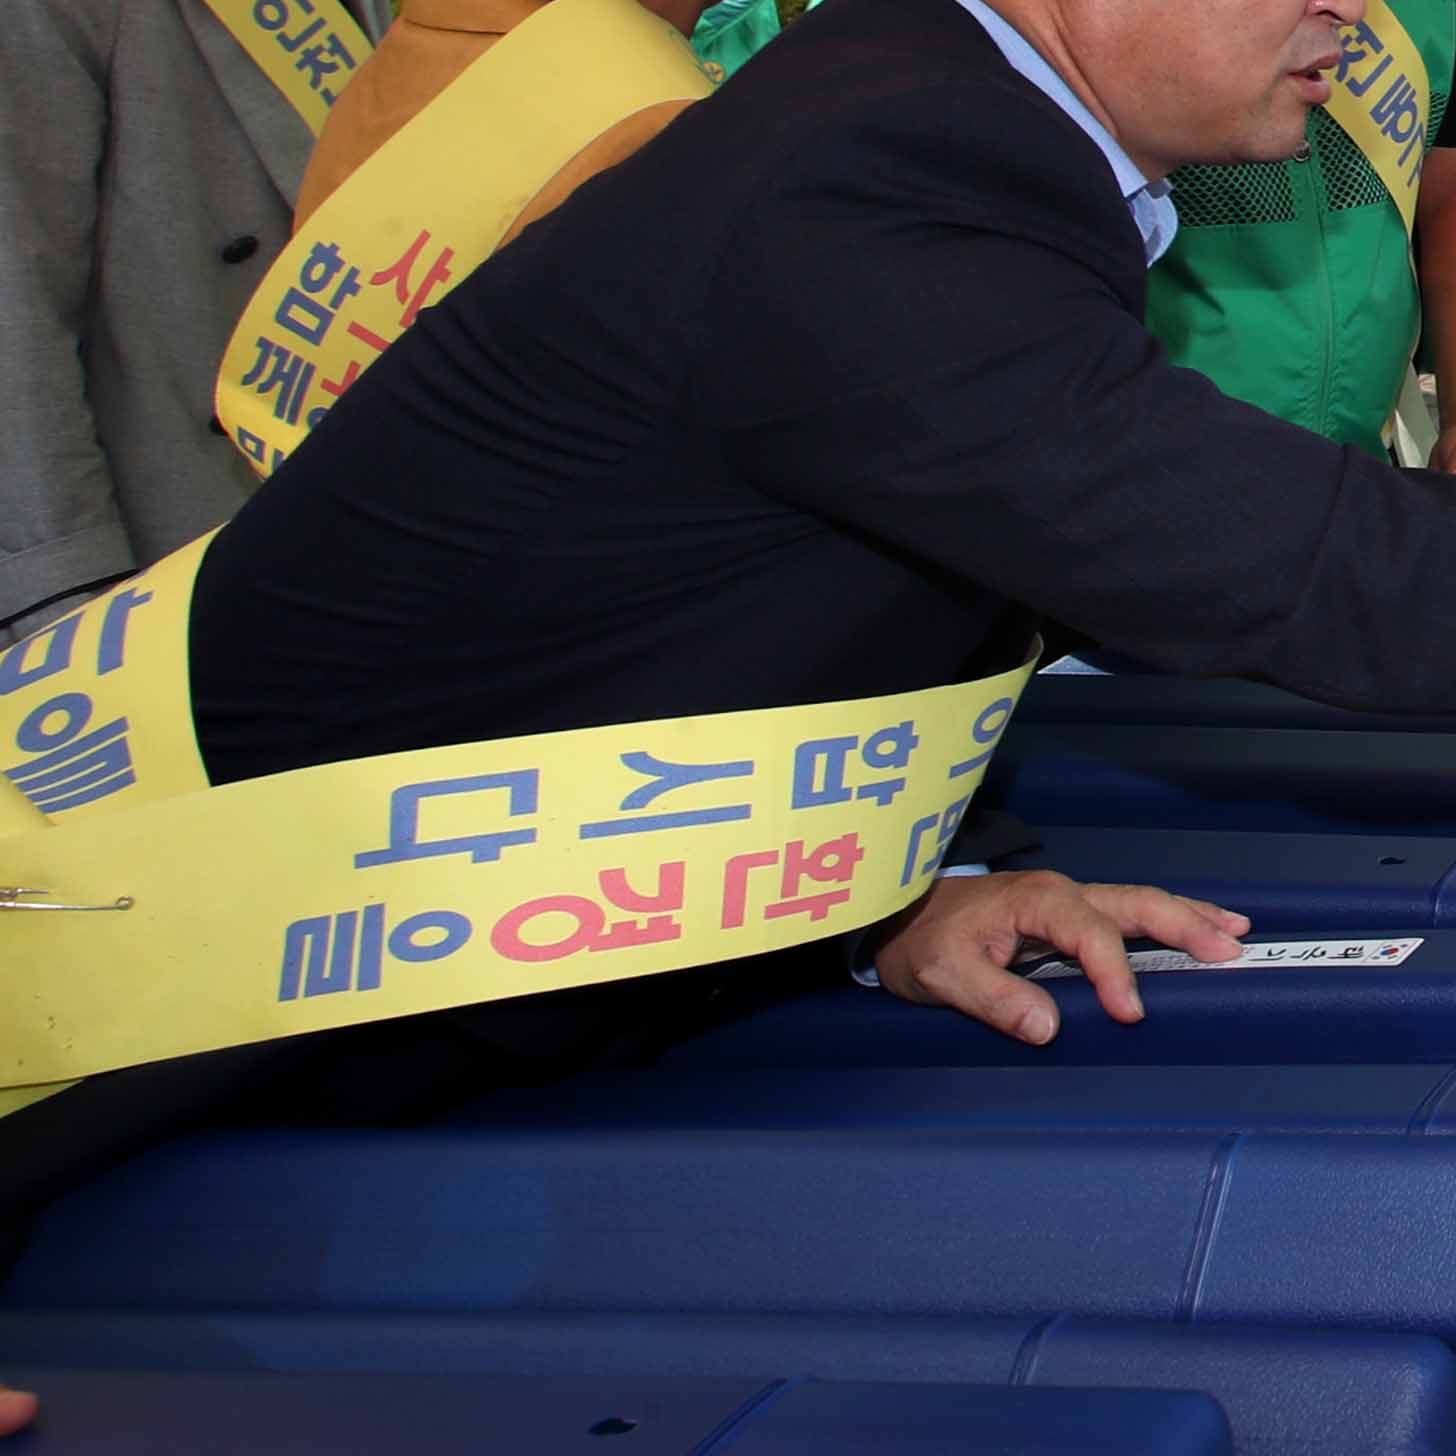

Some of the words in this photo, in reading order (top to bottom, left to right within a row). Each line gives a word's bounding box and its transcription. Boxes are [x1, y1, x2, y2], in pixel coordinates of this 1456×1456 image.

[241, 243, 362, 425] 함께
[353, 719, 921, 870] 합시다
[276, 832, 865, 1004] 환경을
